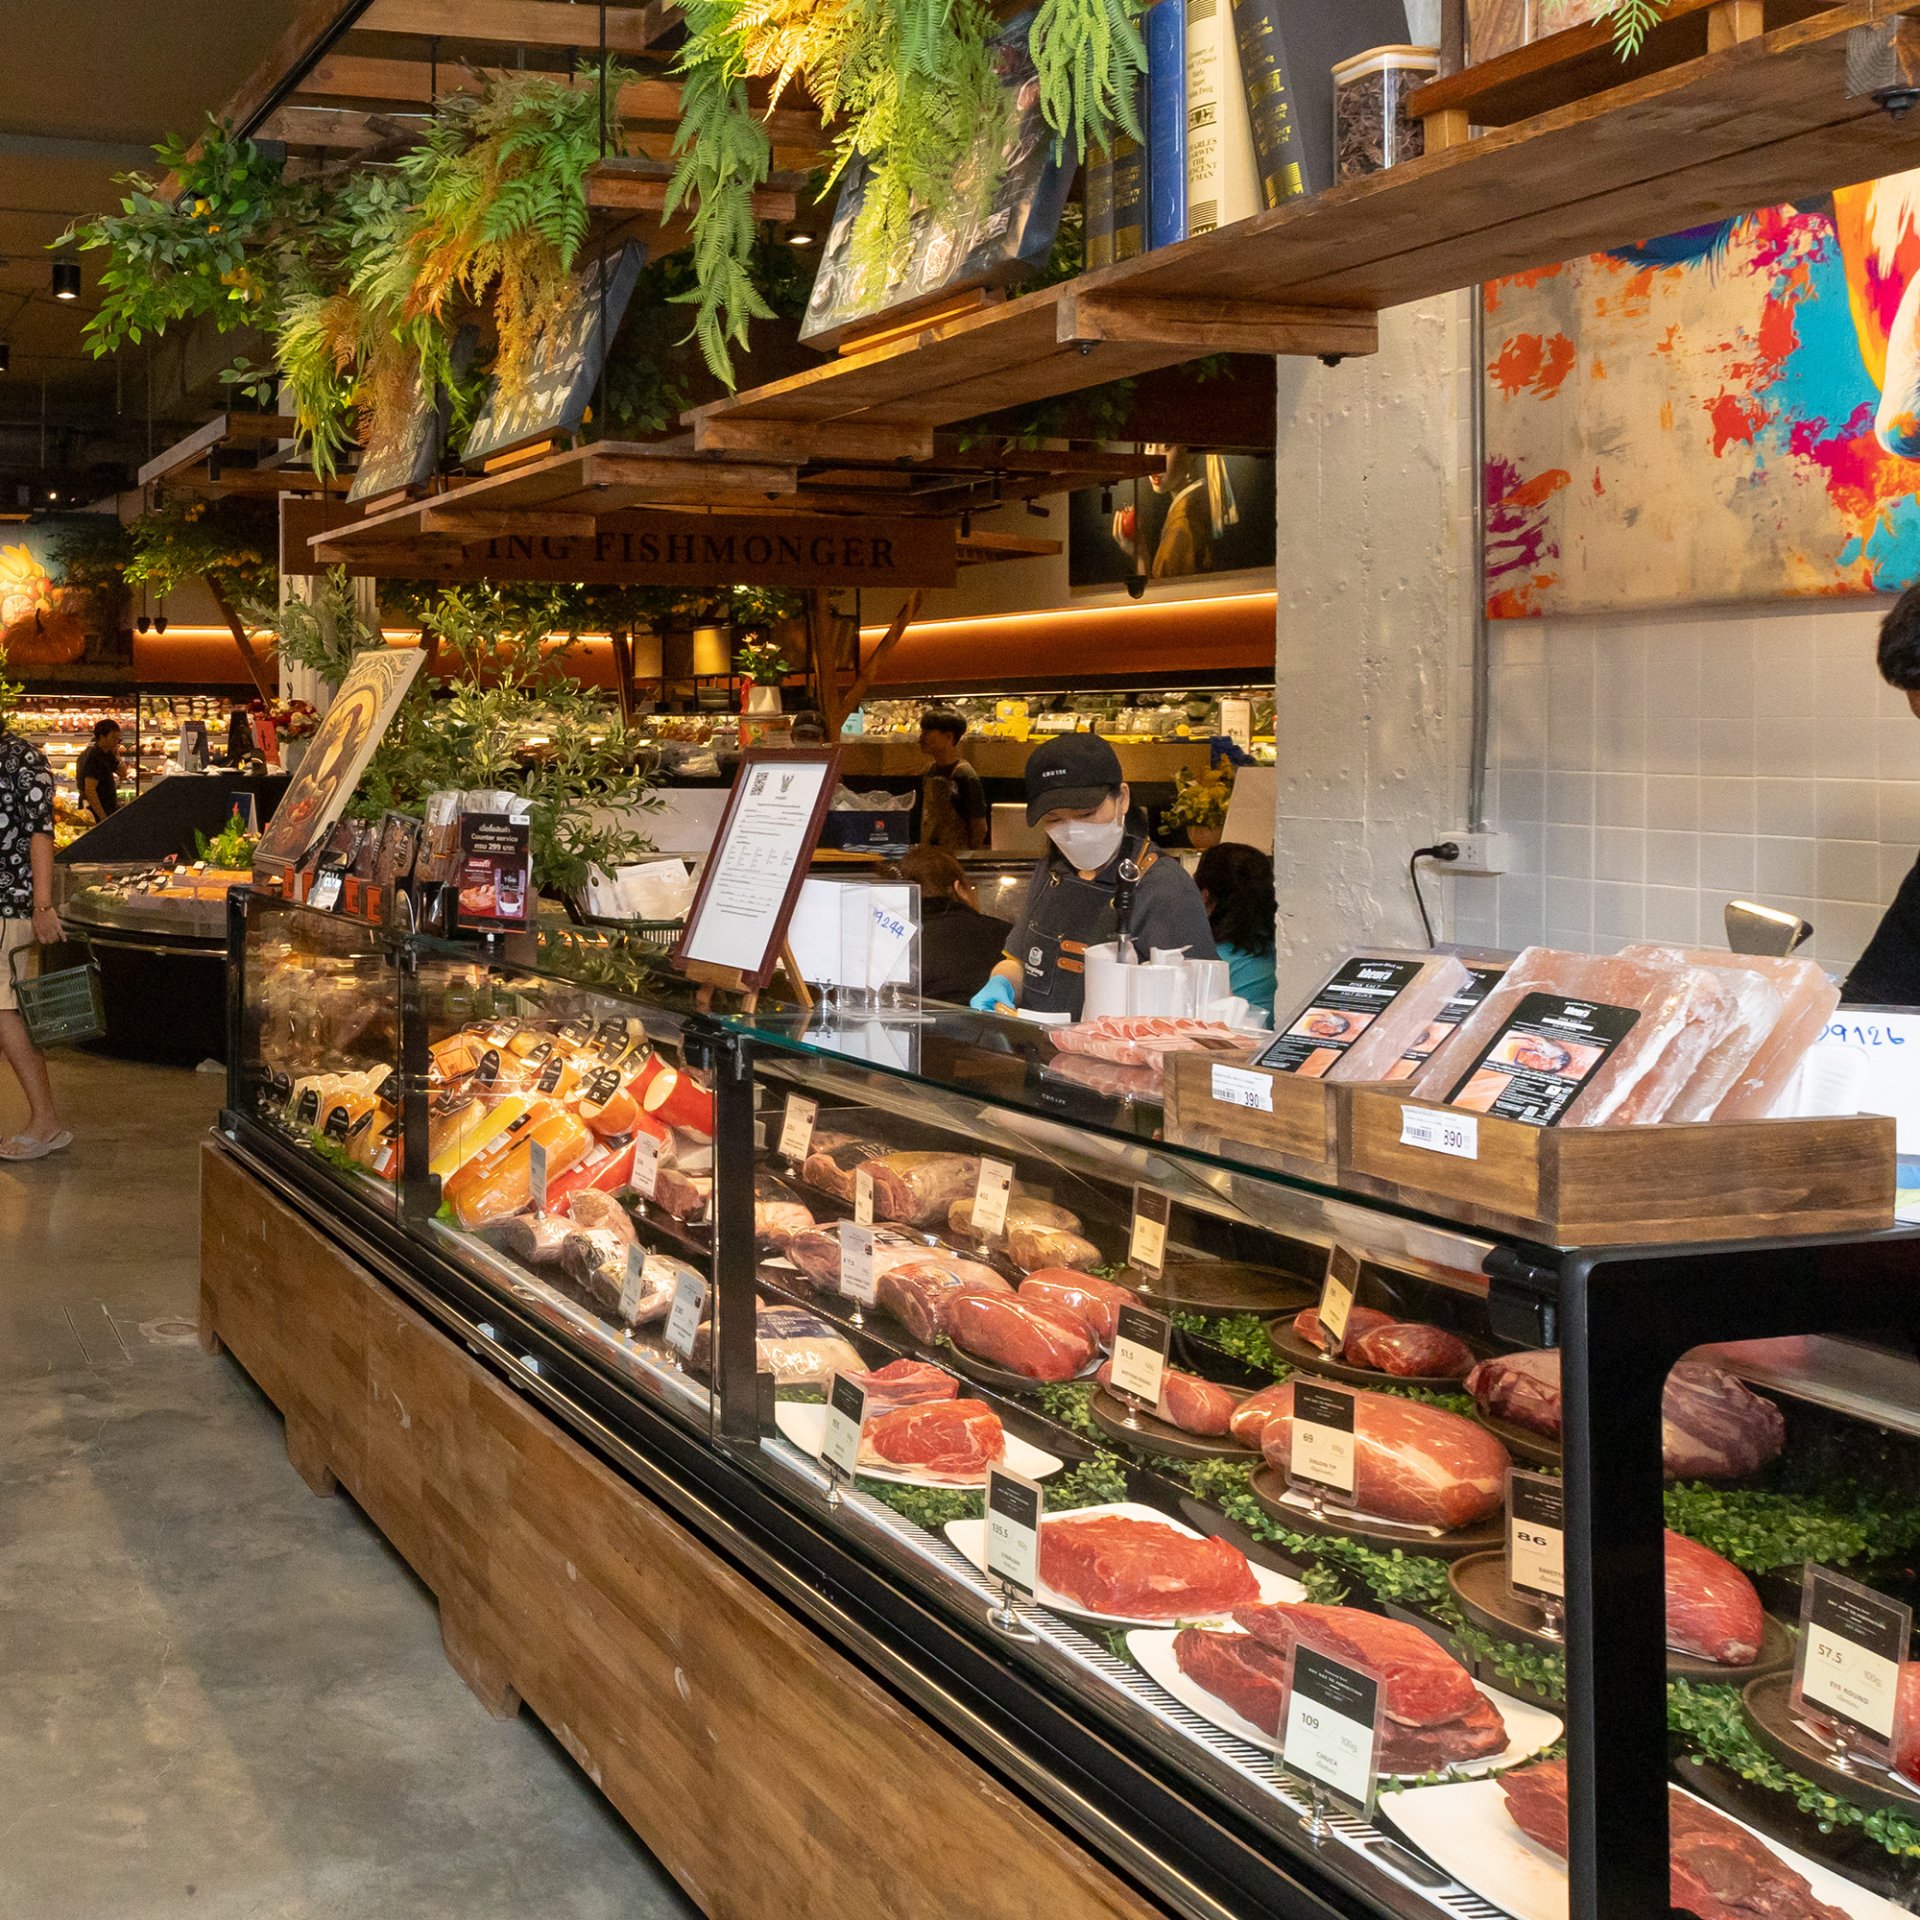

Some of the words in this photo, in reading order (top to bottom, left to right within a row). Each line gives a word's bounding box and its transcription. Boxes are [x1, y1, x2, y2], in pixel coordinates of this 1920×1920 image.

[594, 531, 896, 569] FISHMONGER
[471, 832, 495, 841] Counter
[496, 834, 519, 843] service
[488, 842, 501, 851] 299
[1244, 1091, 1260, 1108] 390
[1517, 1531, 1547, 1546] 86
[1818, 1642, 1843, 1664] 57.5
[1301, 1712, 1320, 1730] 109
